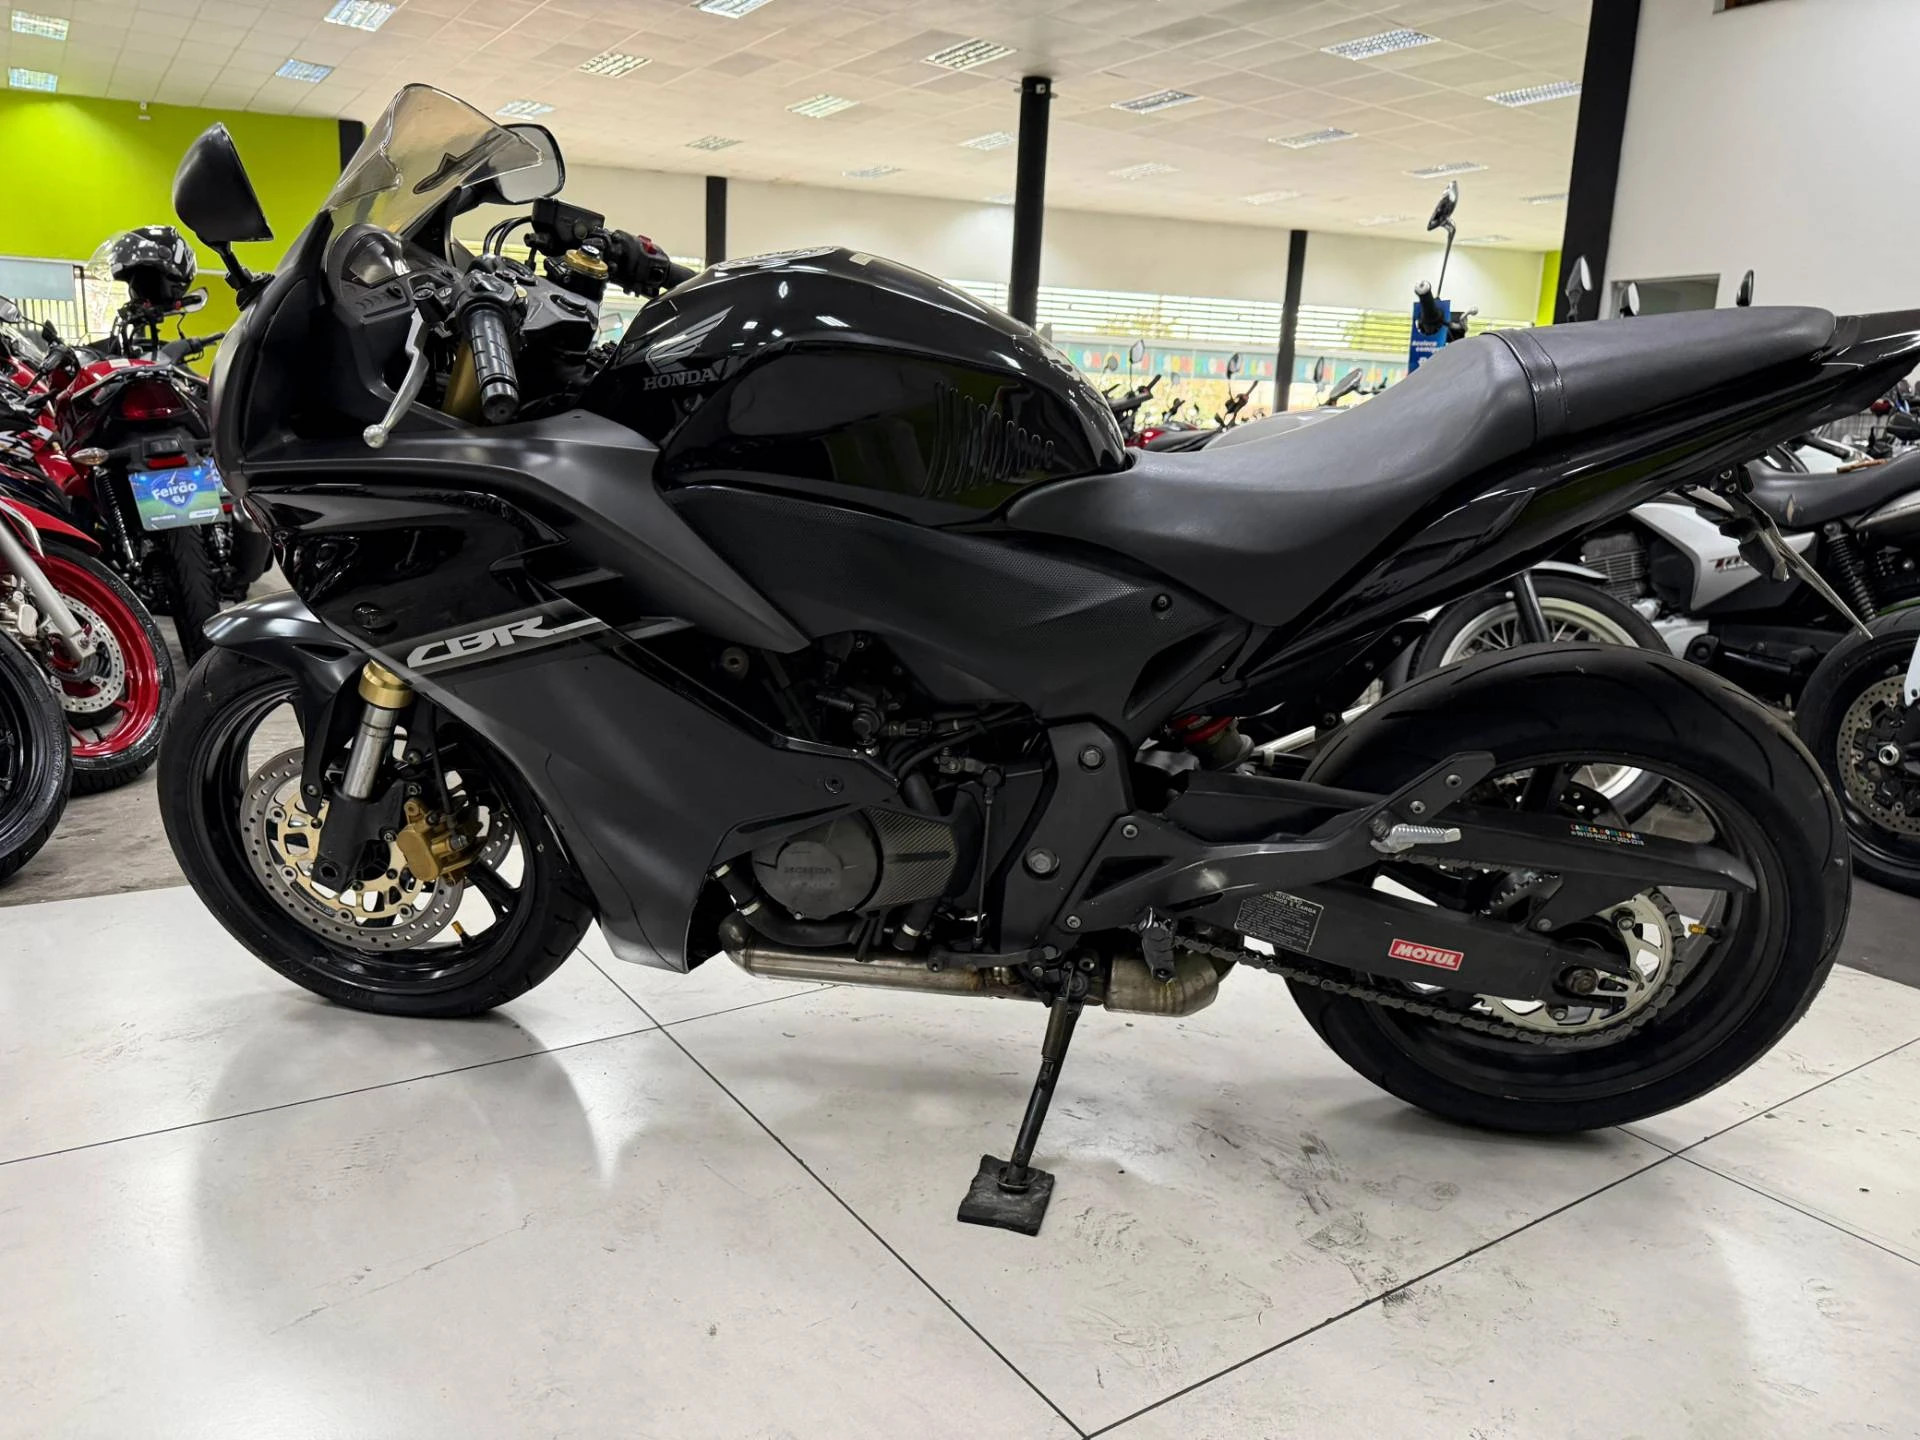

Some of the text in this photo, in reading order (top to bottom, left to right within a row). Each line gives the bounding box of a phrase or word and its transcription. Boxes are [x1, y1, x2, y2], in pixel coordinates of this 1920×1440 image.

[643, 368, 718, 391] HONDA
[151, 481, 198, 501] Feirão
[407, 615, 602, 669] CBR
[1394, 943, 1457, 967] MOTUL
